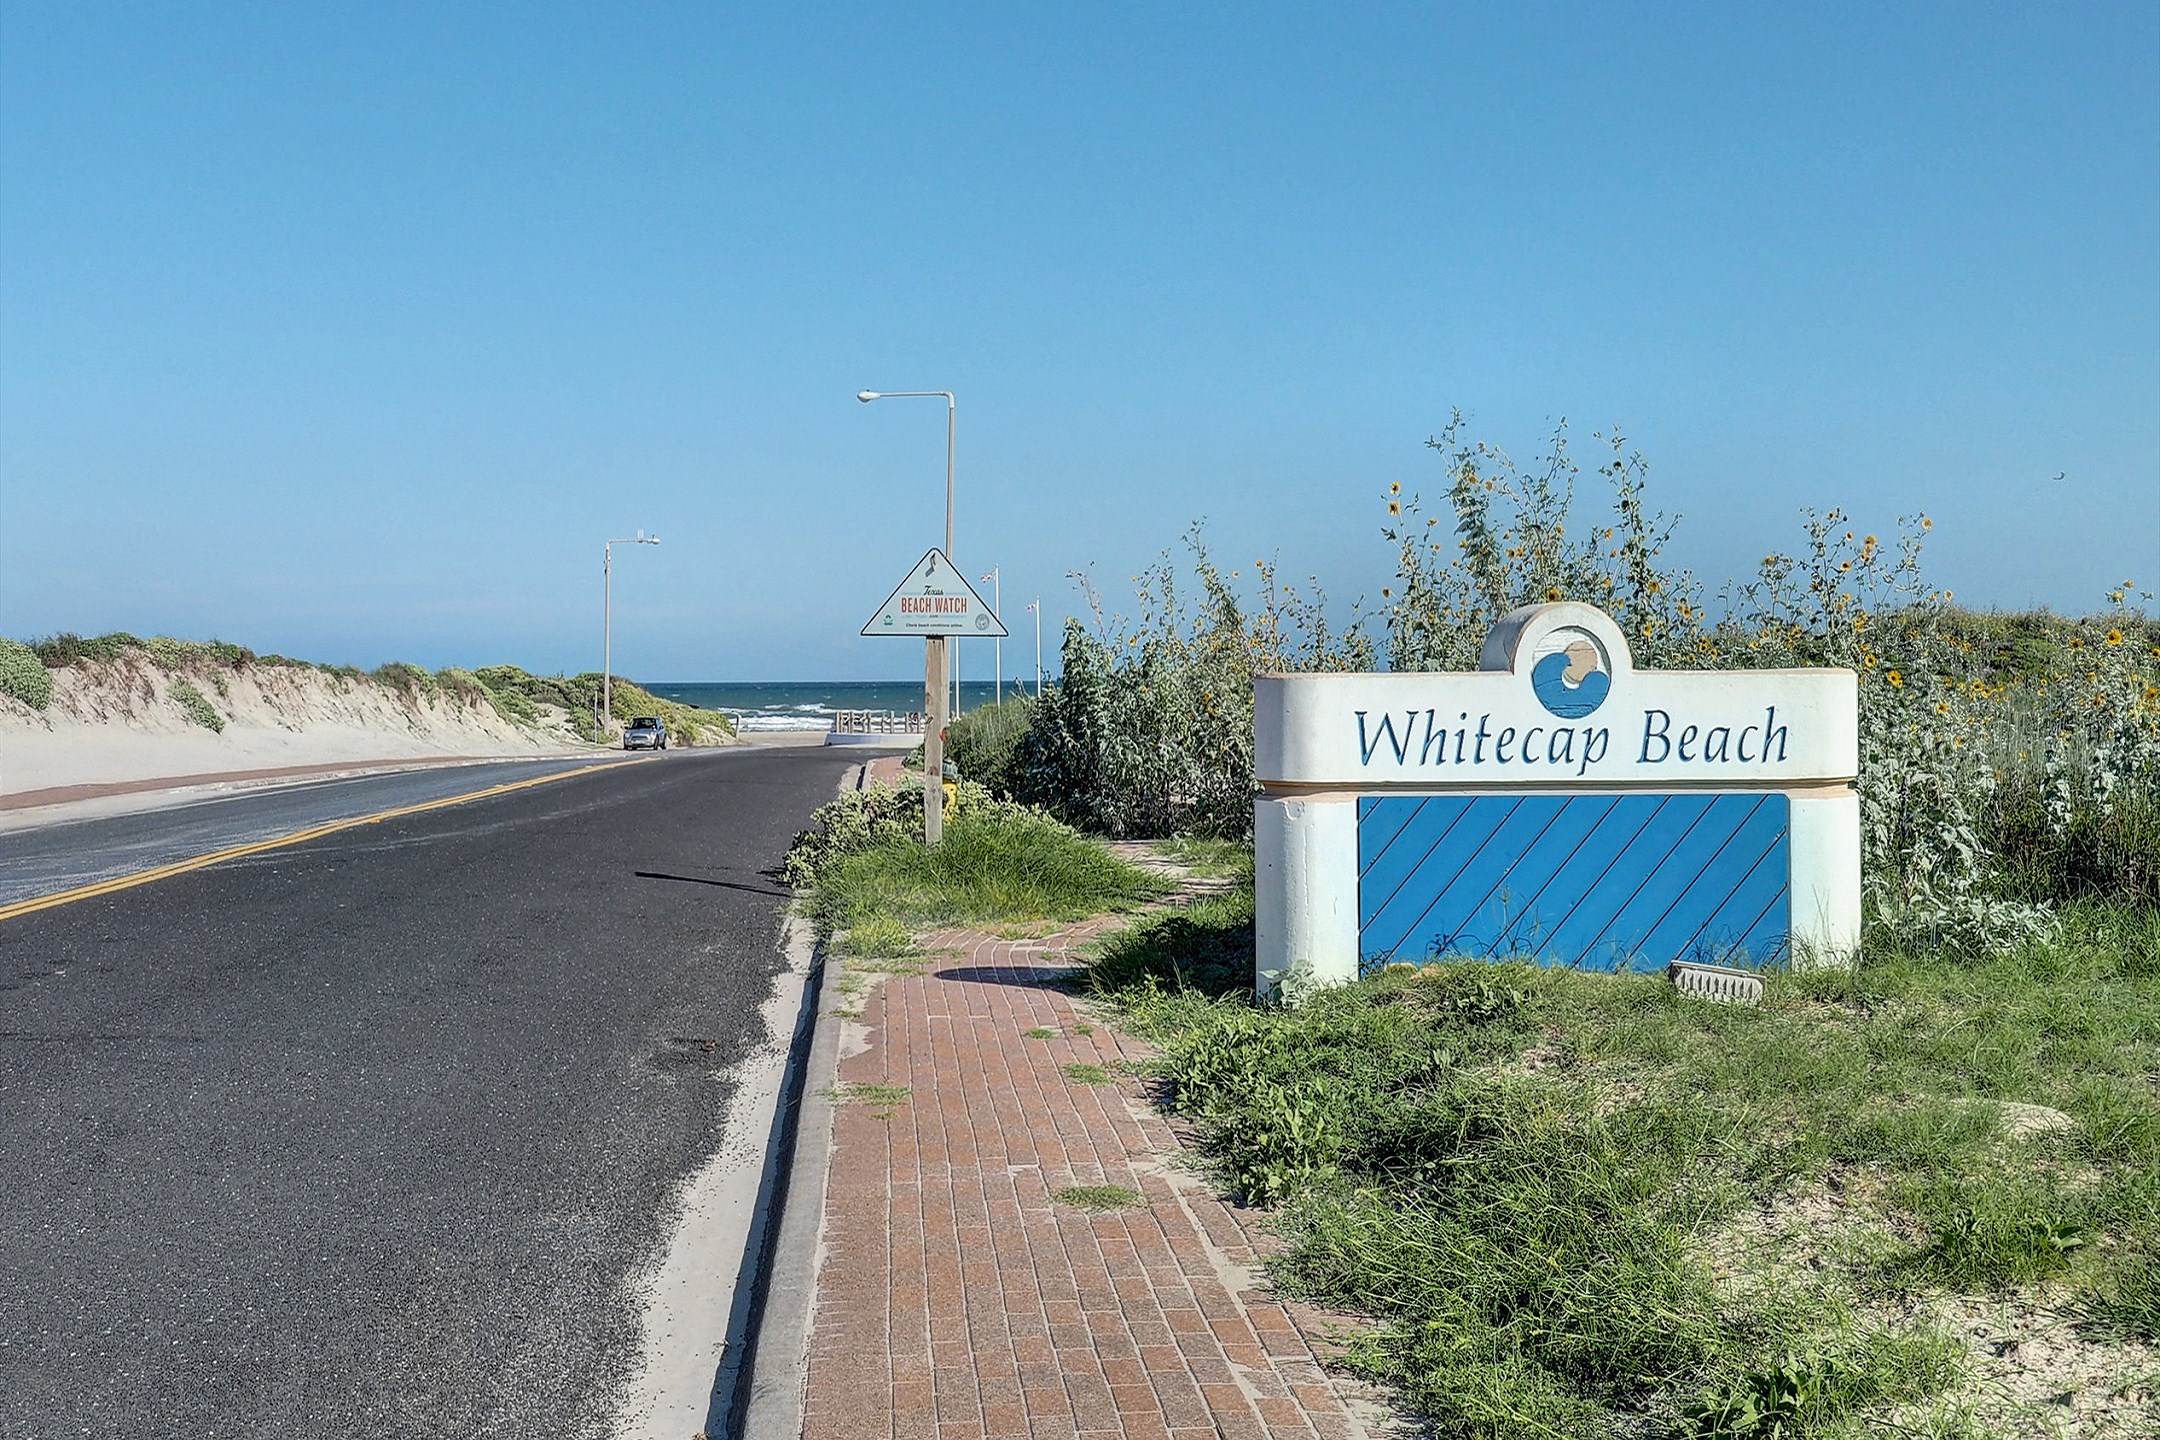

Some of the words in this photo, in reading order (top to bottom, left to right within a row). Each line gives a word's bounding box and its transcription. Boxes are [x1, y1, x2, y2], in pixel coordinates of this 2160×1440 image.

[923, 585, 944, 596] Texas
[901, 597, 931, 613] BEACH
[934, 597, 967, 613] WATCH
[1354, 708, 1610, 777] Whitecap
[1636, 706, 1790, 765] Beach
